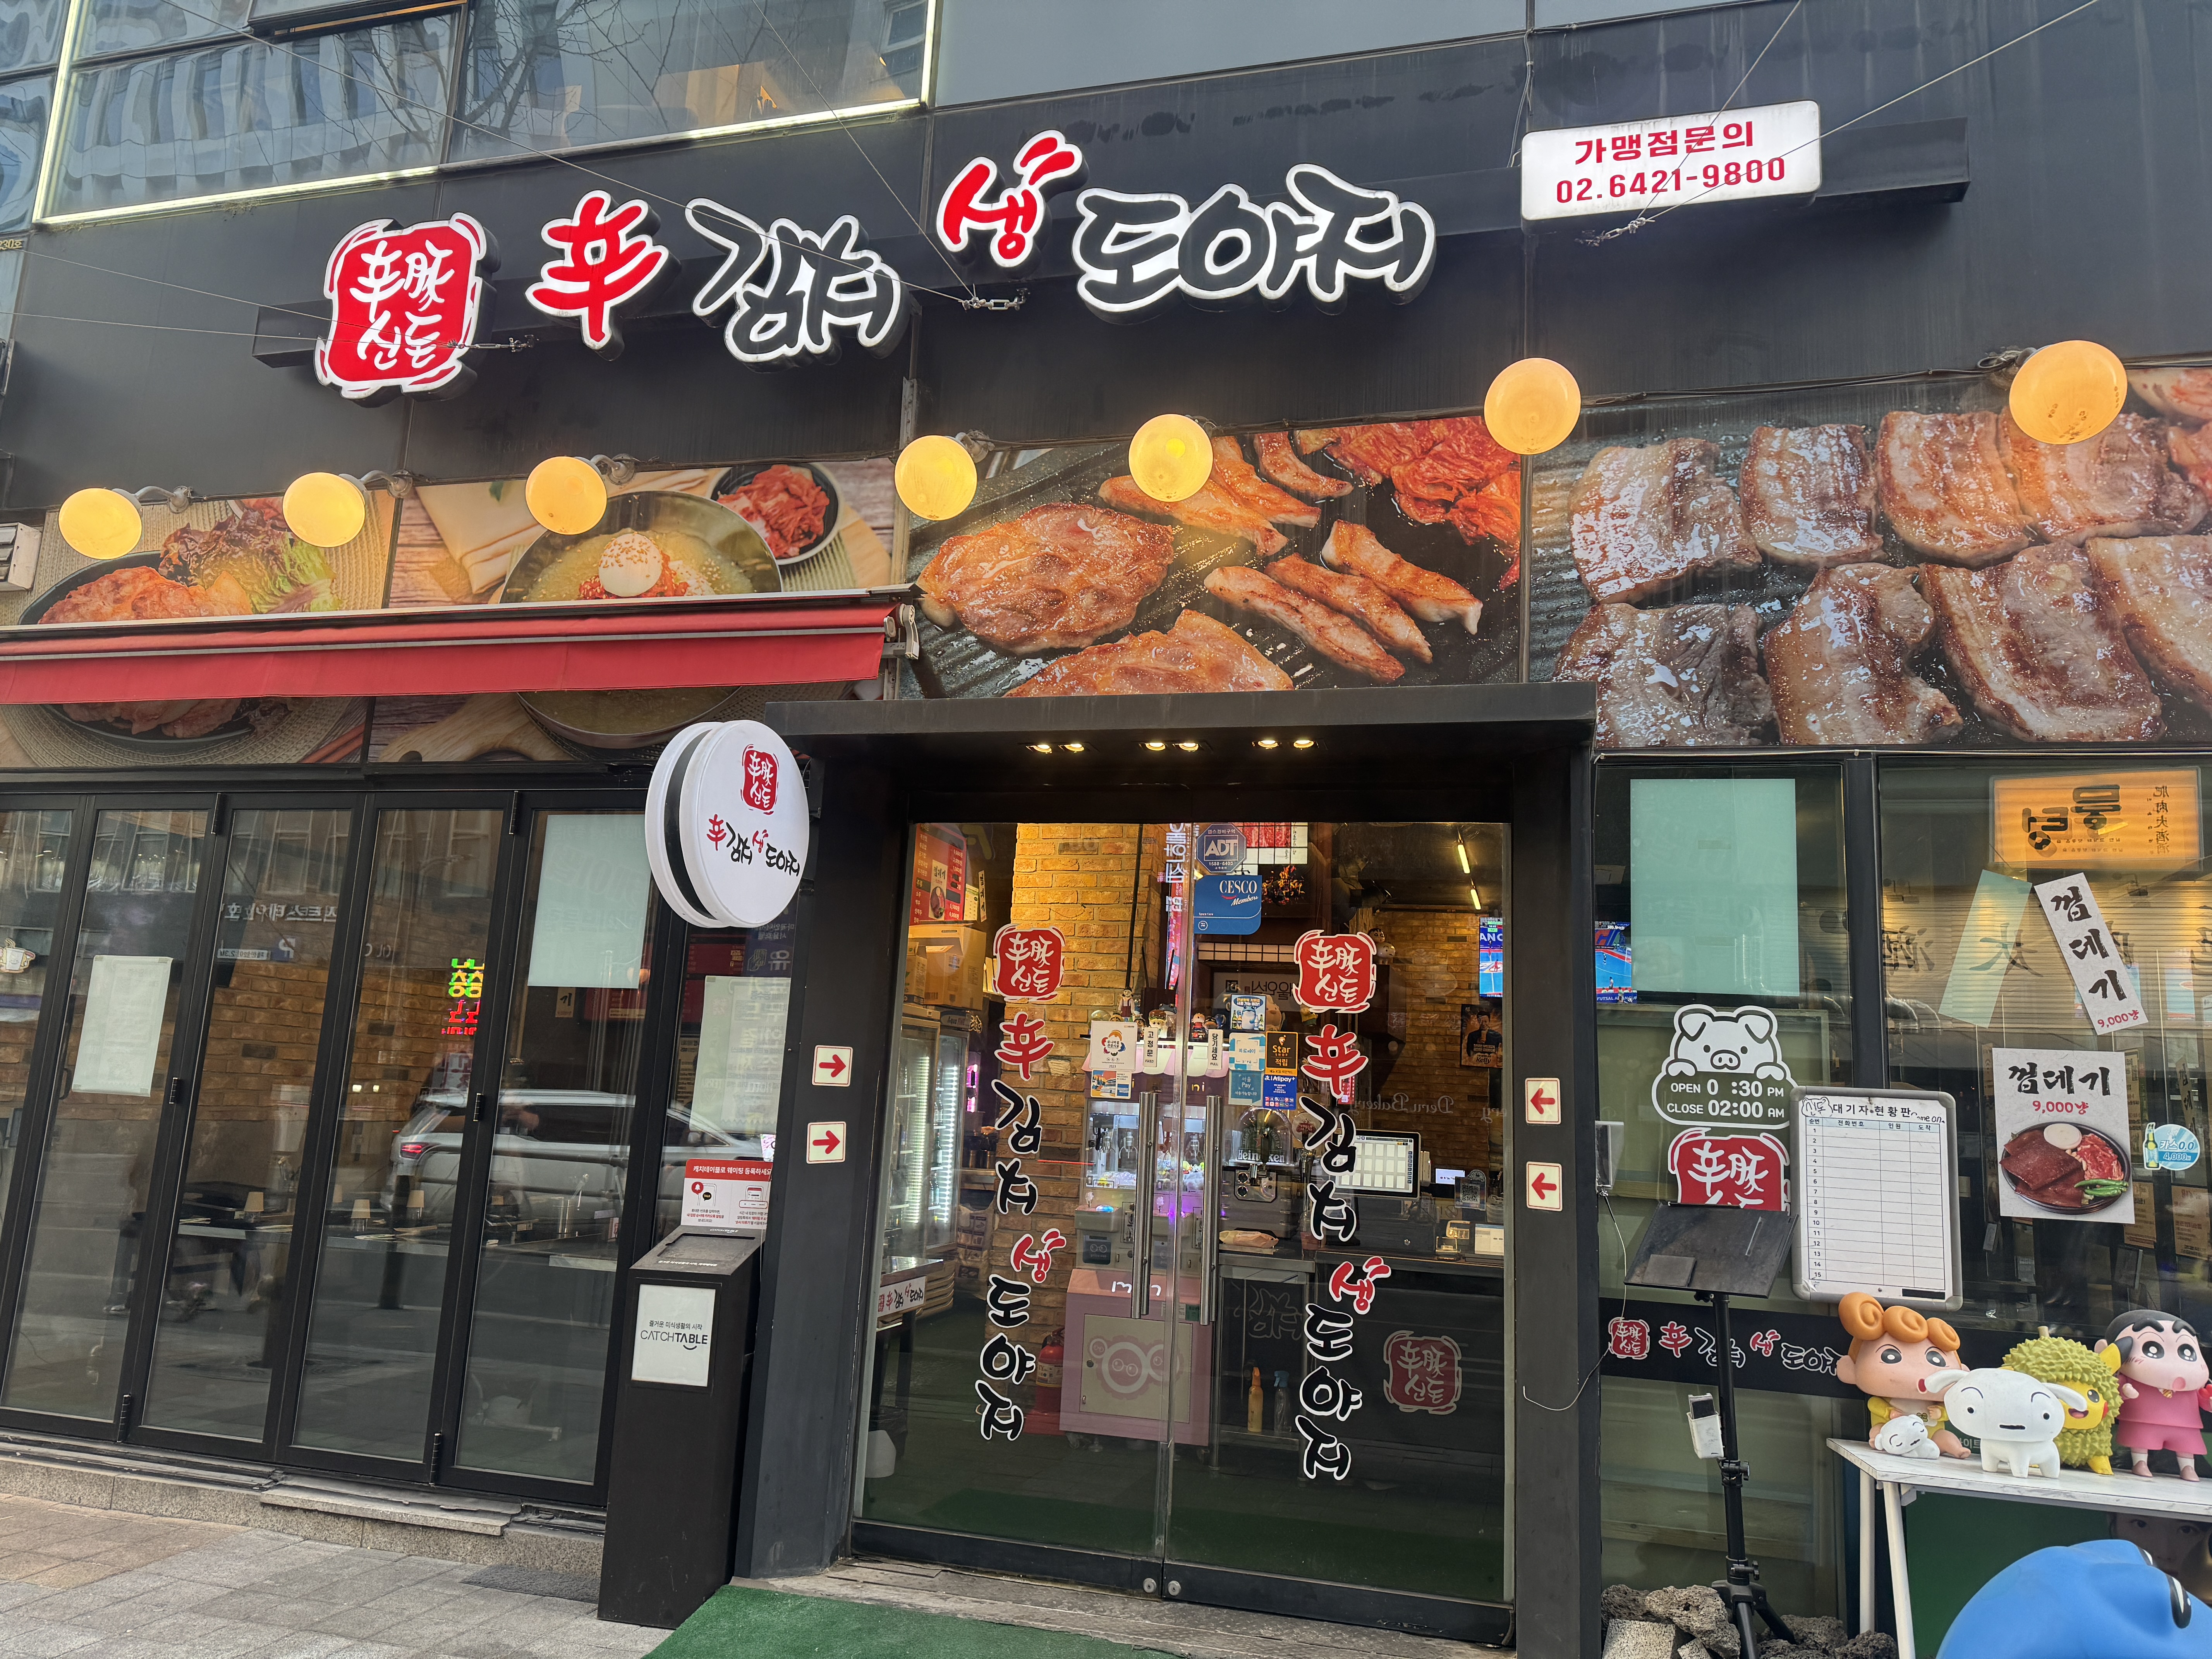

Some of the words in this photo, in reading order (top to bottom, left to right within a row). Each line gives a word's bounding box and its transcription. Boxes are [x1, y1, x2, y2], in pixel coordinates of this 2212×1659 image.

[1574, 121, 1754, 166] 가맹점문의
[1556, 156, 1786, 204] 02.6421-9800
[685, 197, 909, 362] 김치
[936, 129, 1084, 268] 생
[1072, 163, 1437, 311] 도야지
[1204, 839, 1238, 856] ADT
[1219, 880, 1257, 894] CESCO
[1231, 895, 1259, 907] Members
[2050, 885, 2128, 1002] 껍데기
[2008, 1062, 2111, 1096] 껍데기
[1671, 1082, 1701, 1094] OPEN
[1767, 1087, 1784, 1097] PM
[1667, 1103, 1704, 1115] CLOSE
[1708, 1099, 1763, 1118] 02:00
[1768, 1108, 1784, 1118] AM
[1832, 1104, 1868, 1115] 대기자
[1875, 1106, 1911, 1118] 현황판
[2032, 1100, 2089, 1115] 9,000냥
[1238, 1149, 1285, 1163] Heinken
[693, 1165, 726, 1173] 캐치테이블로
[649, 1320, 665, 1328] 즐거운
[665, 1321, 690, 1330] 미식생활의
[640, 1330, 708, 1345] CATCHTABLE
[975, 1273, 1037, 1441] 도야지
[1295, 1303, 1363, 1481] 도야지
